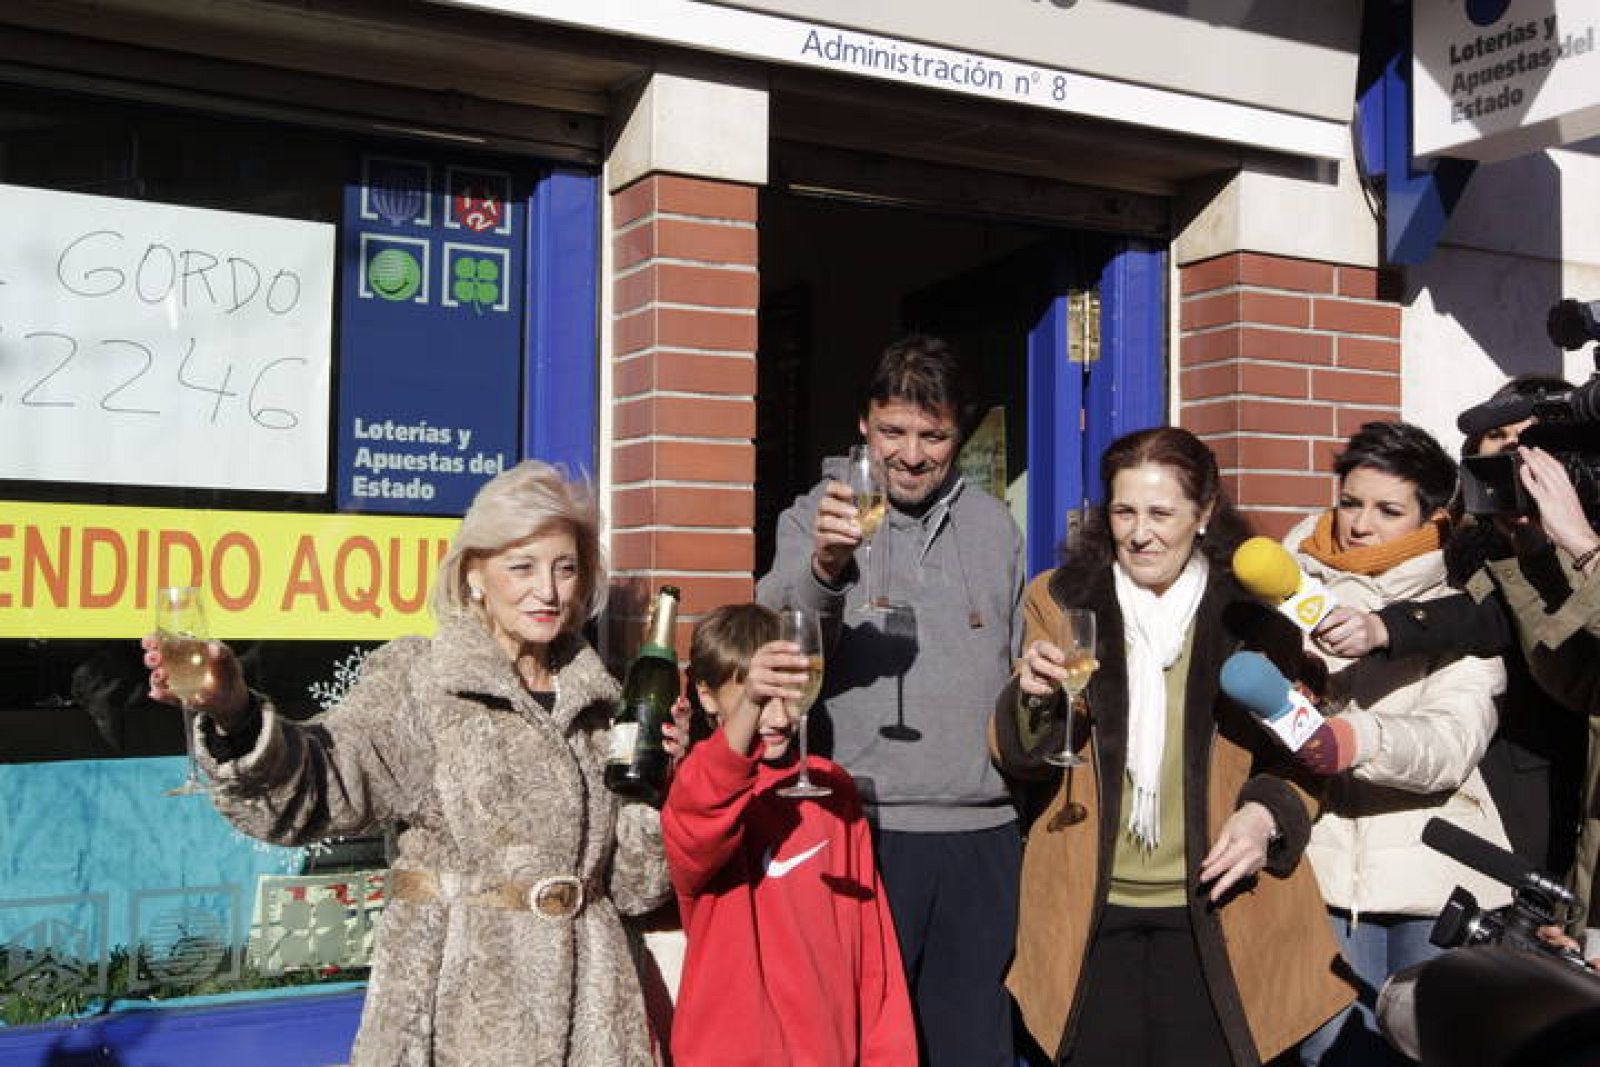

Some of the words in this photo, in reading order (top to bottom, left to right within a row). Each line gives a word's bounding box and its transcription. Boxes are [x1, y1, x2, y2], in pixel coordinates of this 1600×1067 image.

[1544, 15, 1557, 41] y
[801, 29, 1003, 90] Administración
[1052, 75, 1067, 102] 8
[1452, 49, 1552, 95] Apuestas
[1451, 86, 1523, 124] Estado
[57, 231, 300, 315] GORDO
[0, 330, 308, 430] 2246
[457, 428, 472, 450] y
[354, 447, 464, 474] Apuestas
[469, 453, 503, 475] del
[352, 475, 435, 499] Estado
[280, 535, 448, 618] AQU
